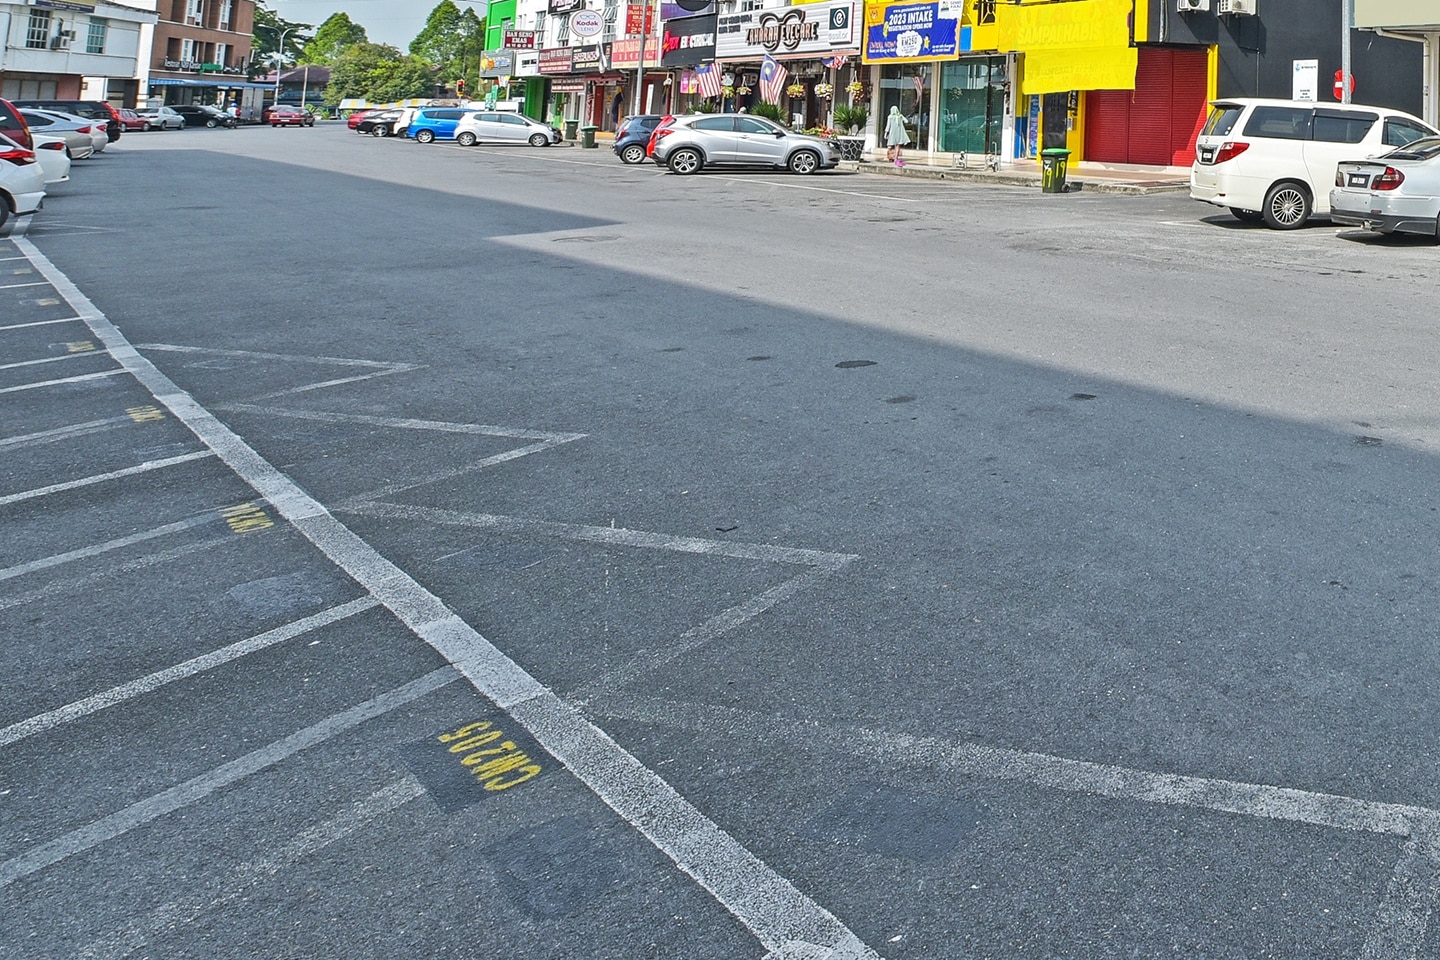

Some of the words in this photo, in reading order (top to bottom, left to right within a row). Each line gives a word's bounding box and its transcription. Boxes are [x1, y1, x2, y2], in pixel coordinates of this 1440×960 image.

[888, 12, 907, 26] 2023
[907, 9, 934, 24] INTAKE
[1056, 161, 1066, 178] 19
